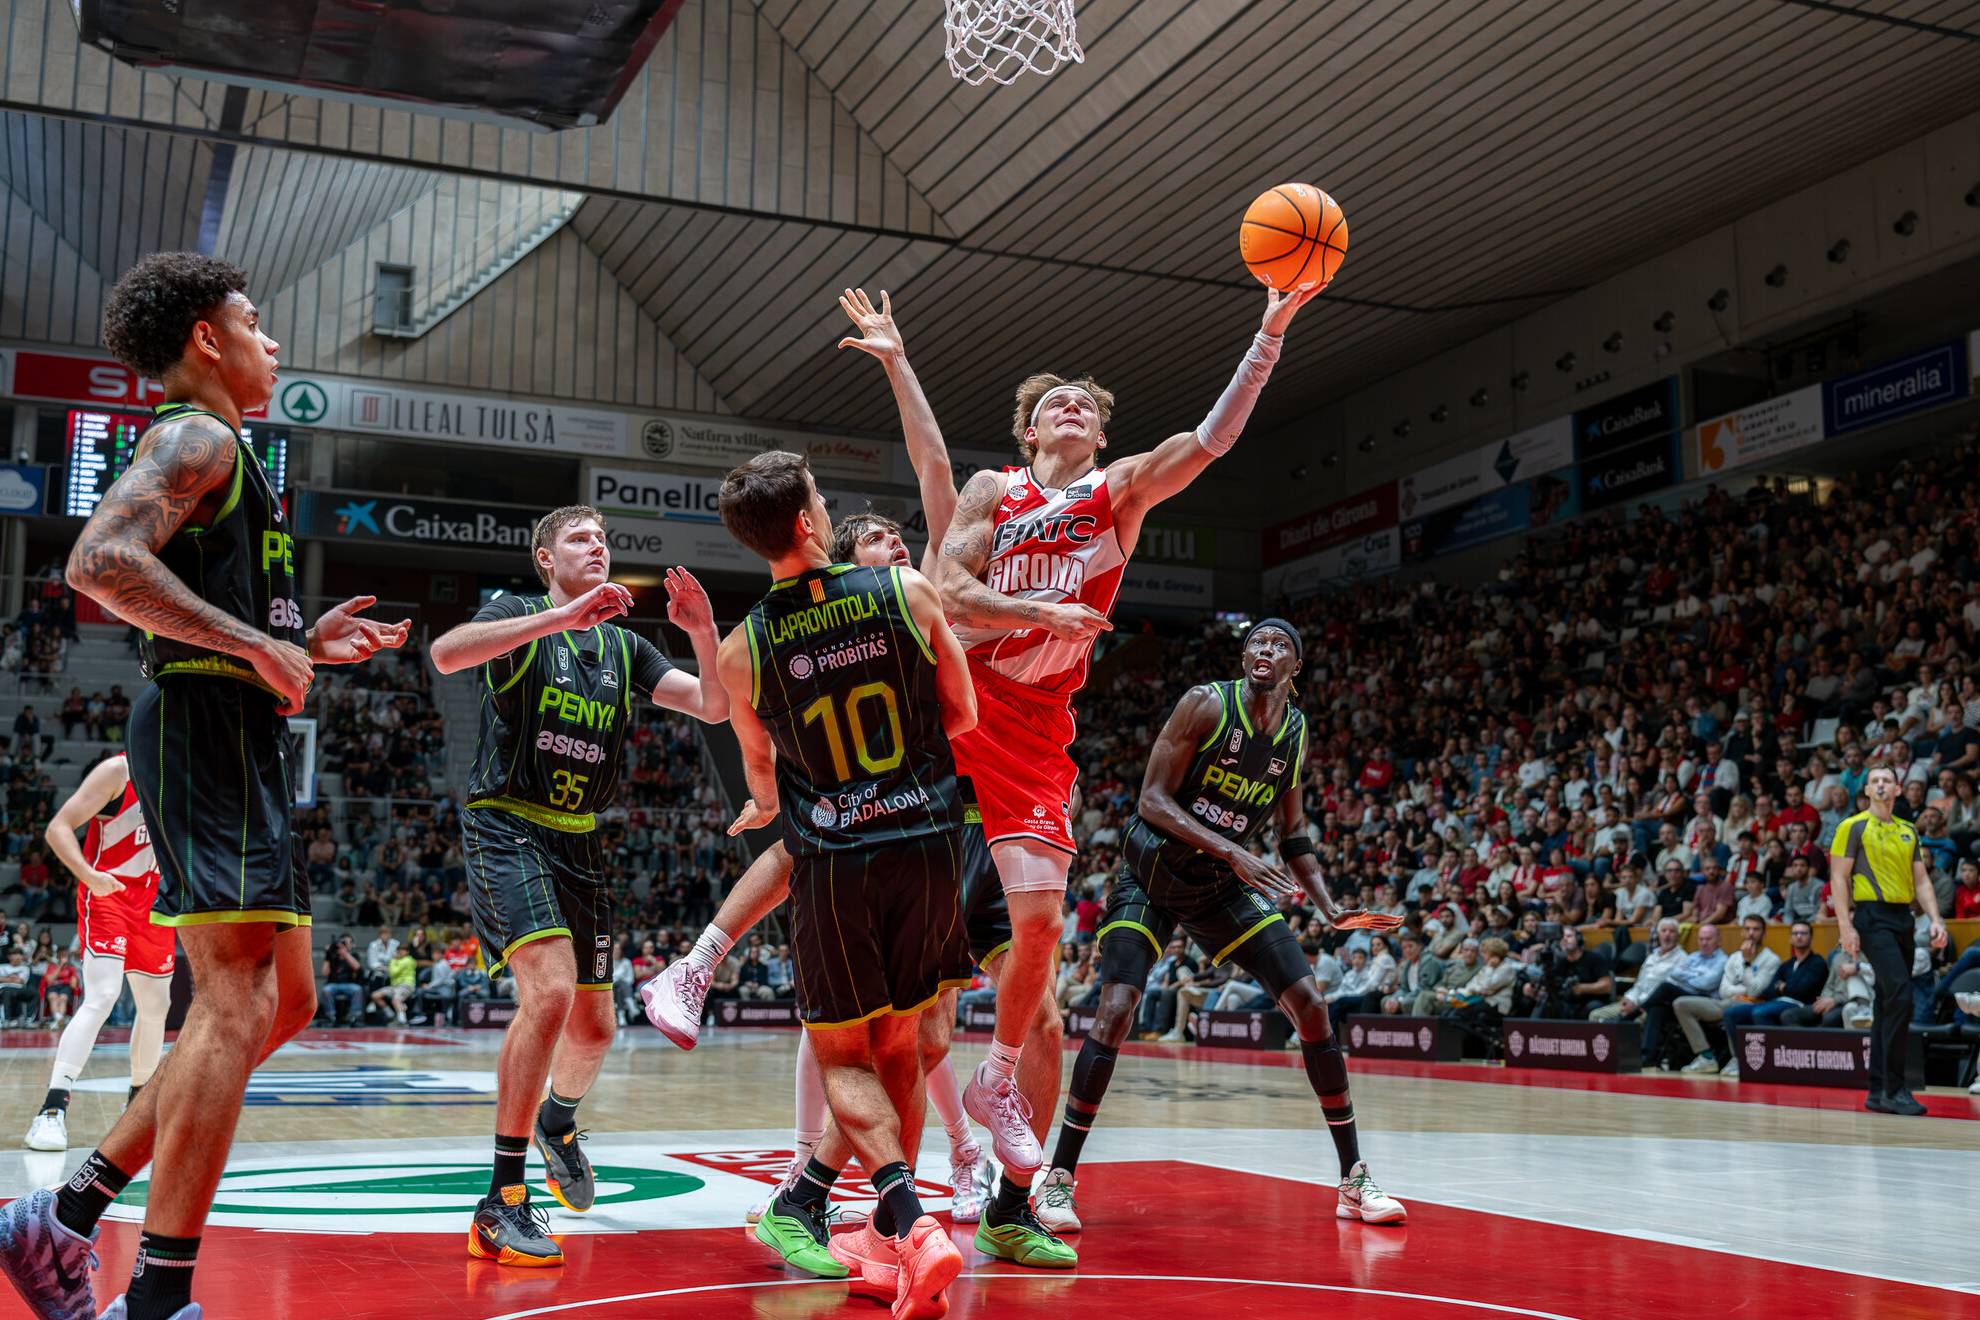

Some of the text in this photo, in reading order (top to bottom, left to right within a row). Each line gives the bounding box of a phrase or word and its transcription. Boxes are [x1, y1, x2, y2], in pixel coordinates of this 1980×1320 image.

[1844, 367, 1941, 416] mineralia
[1602, 400, 1662, 434] CaixaBank
[1604, 454, 1664, 488] CaixaBank
[385, 505, 538, 545] CaixaBan
[993, 514, 1096, 552] FIATC
[987, 553, 1085, 600] GIRONA
[769, 591, 880, 644] LAPROVITTOLA
[817, 639, 888, 673] PROBITAS
[538, 685, 616, 732] PENYA
[803, 681, 905, 782] 10
[550, 768, 589, 811] 35
[838, 783, 878, 810] City of
[1202, 764, 1276, 808] PENYA
[840, 786, 930, 829] BADALONA
[1192, 796, 1249, 833] asisa
[1773, 1045, 1855, 1071] BÀSQUET GIRONA
